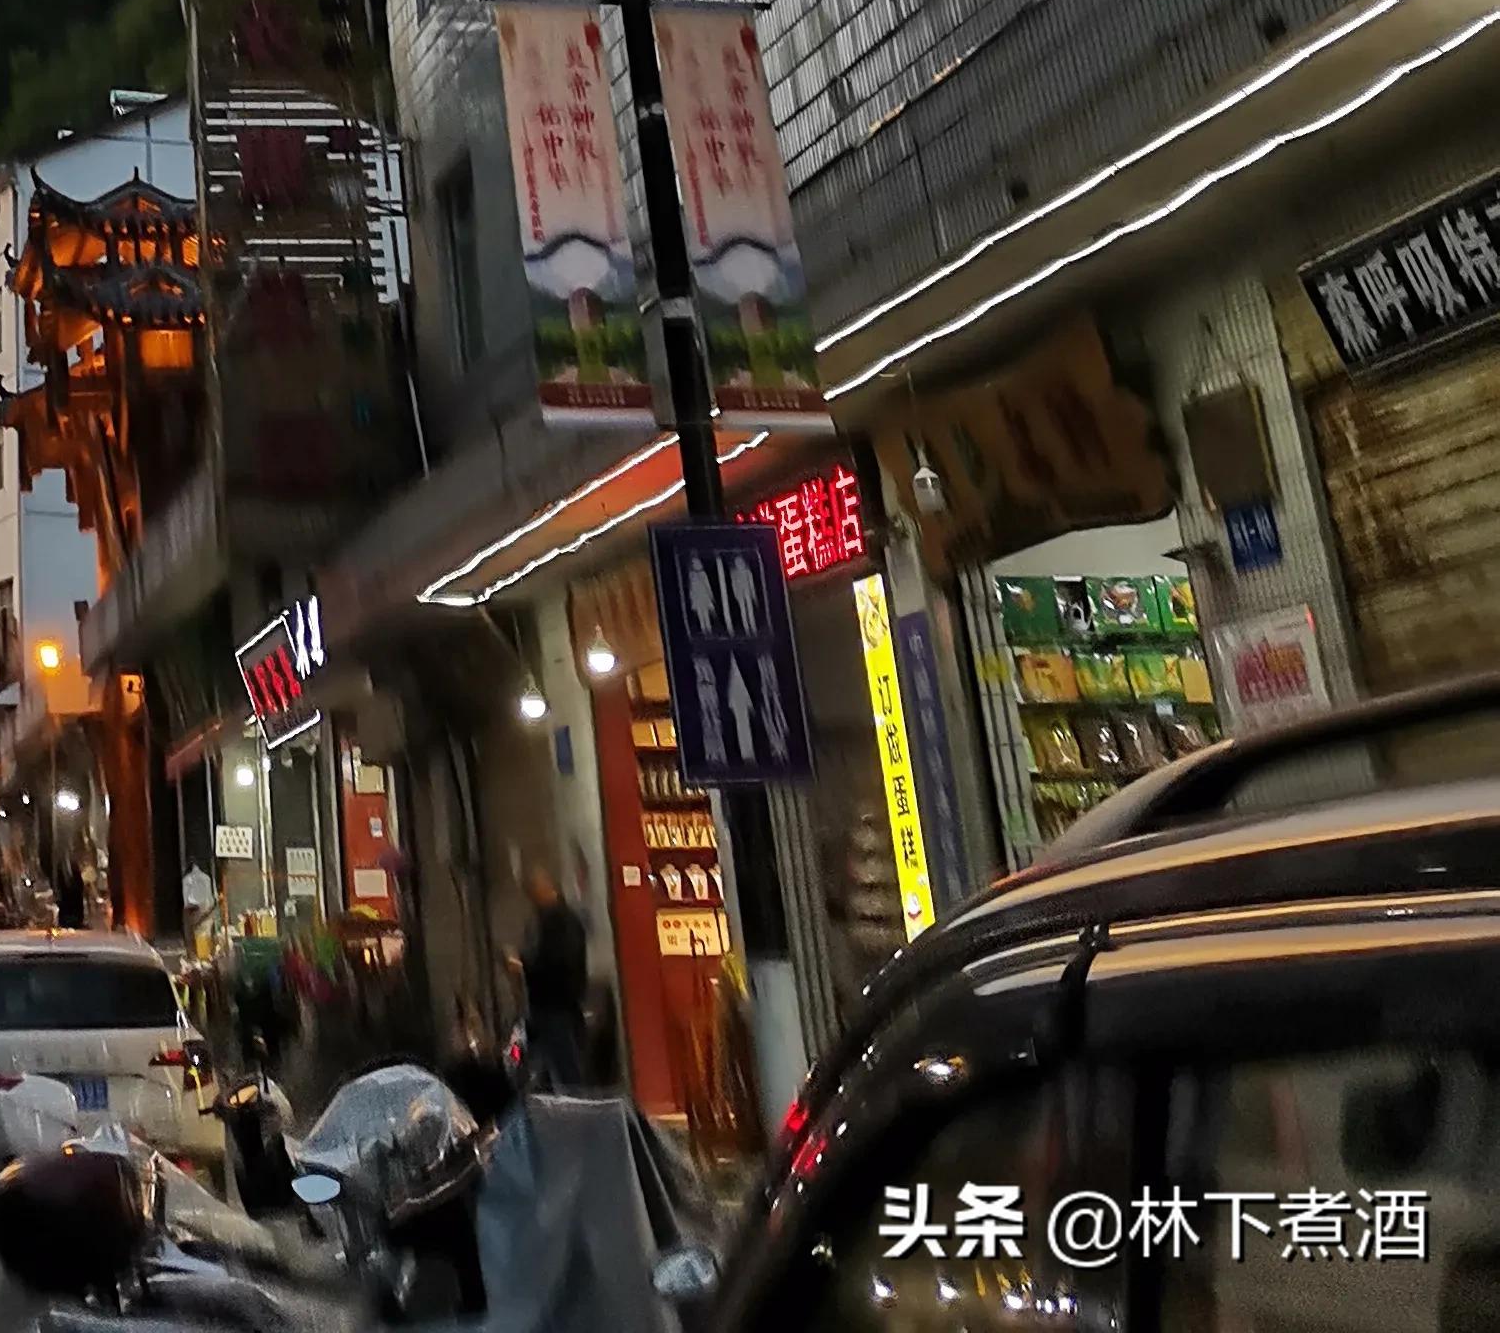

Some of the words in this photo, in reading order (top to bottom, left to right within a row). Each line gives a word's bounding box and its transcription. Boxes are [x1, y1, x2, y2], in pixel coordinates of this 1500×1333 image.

[1318, 189, 1500, 365] 森呼吸特
[737, 465, 864, 577] 蛋糕店
